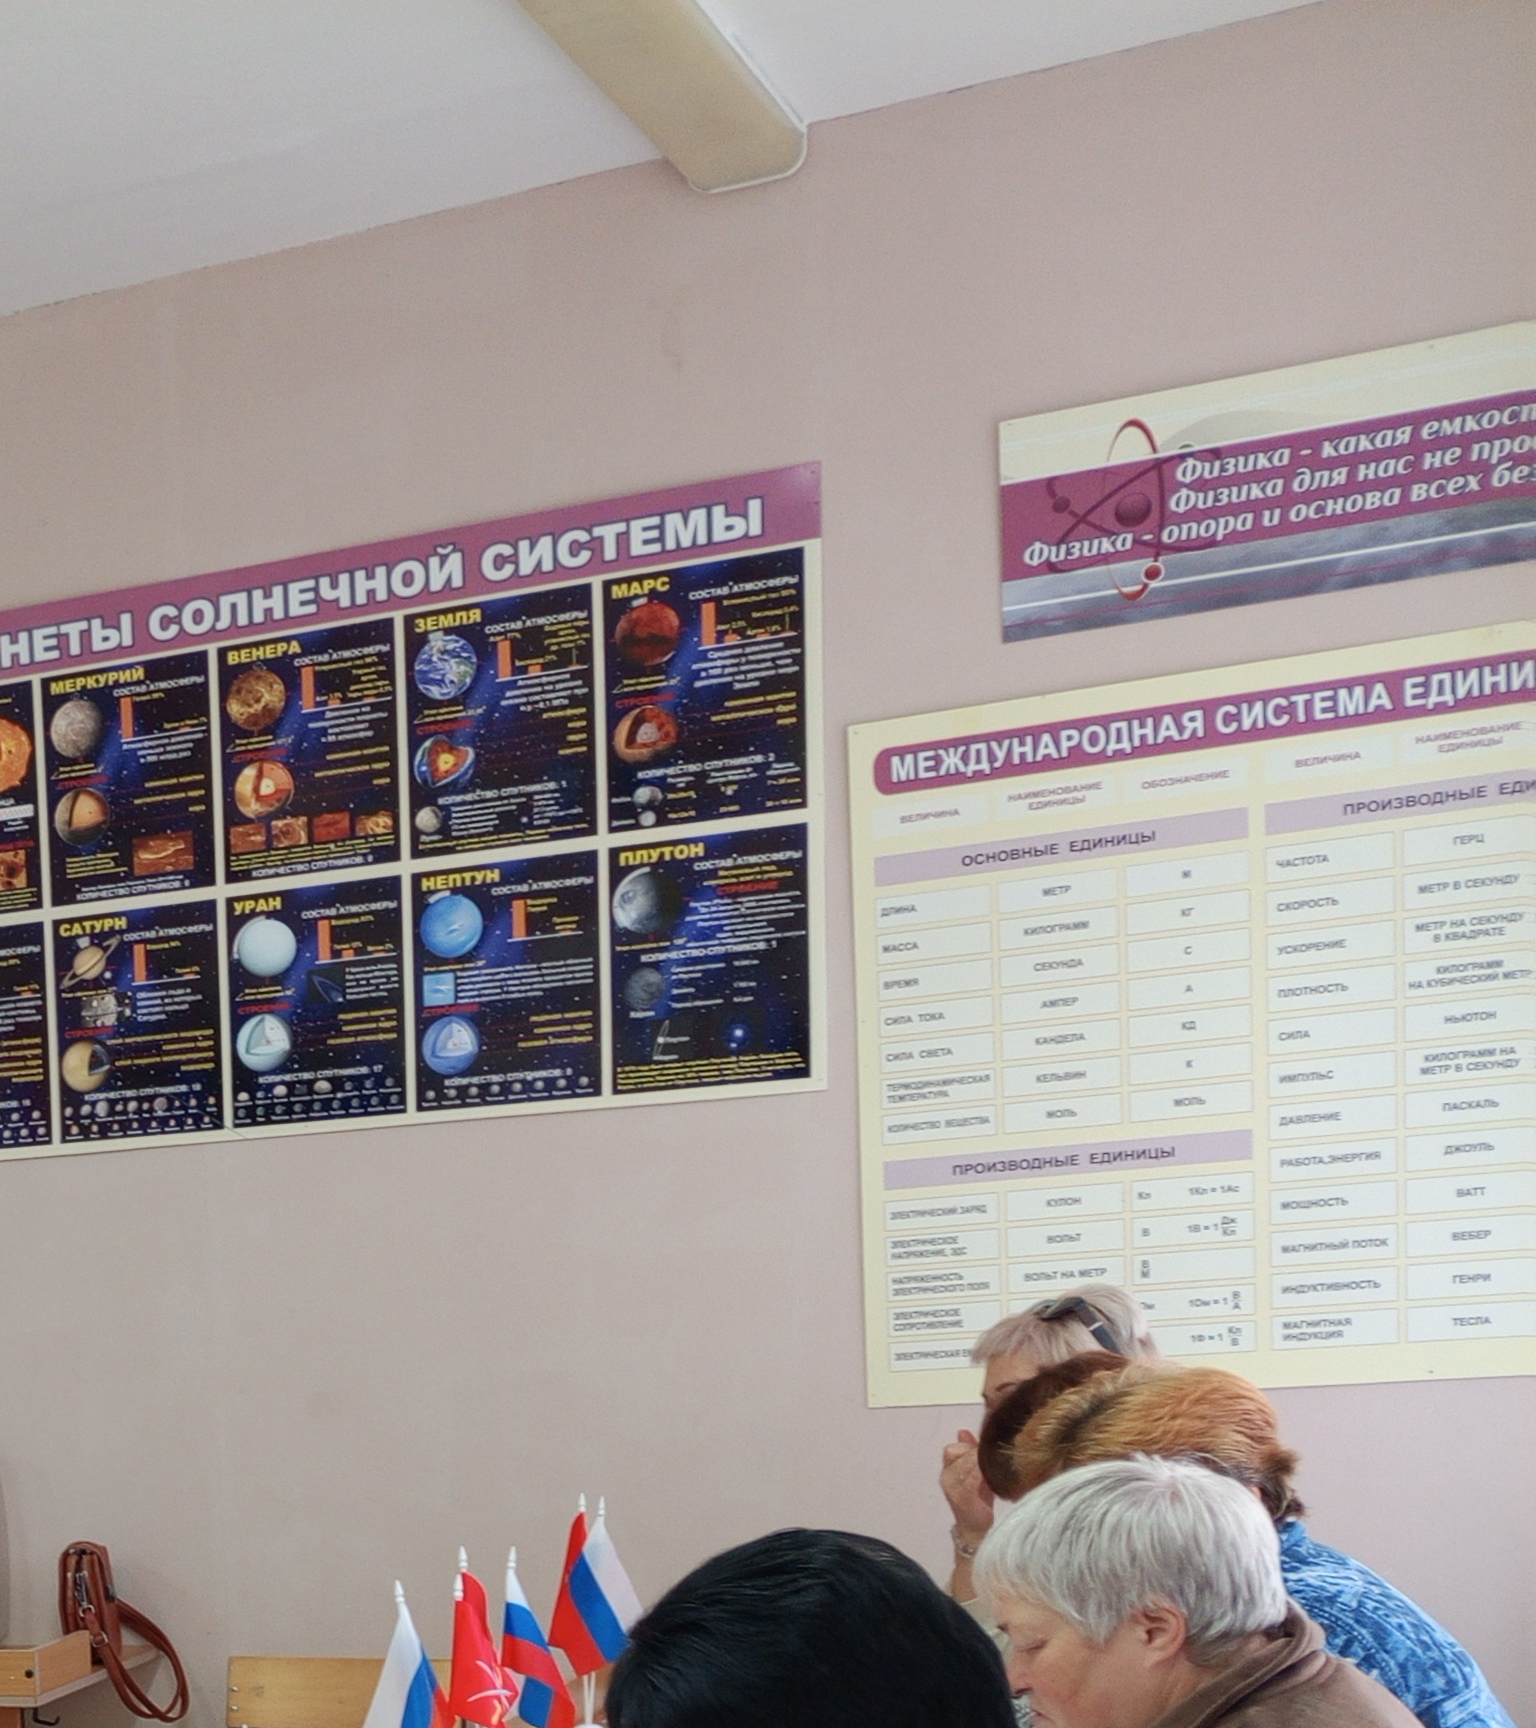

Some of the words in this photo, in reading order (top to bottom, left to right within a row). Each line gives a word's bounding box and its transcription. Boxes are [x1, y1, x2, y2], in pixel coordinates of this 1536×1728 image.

[1175, 447, 1290, 483] Физика
[1322, 425, 1410, 459] какая
[1170, 478, 1283, 513] Физика
[1293, 467, 1345, 492] для
[1357, 454, 1415, 480] нас
[1423, 447, 1462, 470] не
[1471, 434, 1536, 464] про
[1024, 533, 1133, 567] Физика
[1161, 512, 1253, 544] опора
[1261, 507, 1280, 526] и
[1288, 487, 1399, 523] основа
[1411, 474, 1483, 502] всех
[148, 547, 465, 643] СОЛНЕЧНОЙ
[480, 498, 765, 584] СИСТЕМЫ
[611, 576, 671, 599] МАРС
[414, 608, 482, 633] ЗЕМЛЯ
[227, 639, 302, 665] ВЕНЕРА
[51, 667, 145, 695] МЕРКУРИЙ
[890, 709, 1204, 783] МЕЖДУНАРОДНАЯ
[1215, 682, 1393, 735] СИСТЕМА
[1403, 660, 1536, 708] ЕДИНИ
[1415, 722, 1523, 745] НАИМЕНОВАНИЕ
[1438, 737, 1503, 754] ЕДИНИЦЫ
[1295, 751, 1361, 768] ВЕЛИЧИНА
[1141, 770, 1230, 791] ОБОЗНАЧЕНИЕ
[619, 842, 705, 866] ПЛУТОН
[961, 842, 1060, 867] ОСНОВНЫЕ
[1069, 830, 1156, 853] ЕДИНИЦЫ
[1276, 855, 1329, 869] ЧАСТОТА
[421, 869, 500, 892] НЕПТУН
[1041, 886, 1072, 898] МЕТР
[233, 897, 282, 915] УРАН
[1277, 897, 1339, 912] СКОРОСТЬ
[59, 917, 127, 937] САТУРН
[882, 941, 919, 953] МАССА
[1277, 939, 1347, 956] УСКОРЕНИЕ
[1034, 958, 1084, 972] СЕКУНДА
[883, 978, 919, 990] ВРЕМЯ
[1278, 983, 1349, 999] ПЛОТНОСТЬ
[918, 1011, 945, 1022] ТОКА
[1444, 1011, 1497, 1025] НЬЮТОН
[1035, 1032, 1086, 1046] КАНДЕЛА
[1036, 1069, 1086, 1084] КЕЛЬВИН
[1279, 1070, 1334, 1084] ИМПУЛЬС
[1442, 1099, 1500, 1112] ПАСКАЛЬ
[1279, 1112, 1342, 1127] ДАВЛЕНИЕ
[952, 1154, 1080, 1177] ПРОИЗВОДНЫЕ
[1089, 1146, 1177, 1166] ЕДИНИЦЫ
[1456, 1187, 1486, 1198] ВАТТ
[1281, 1197, 1349, 1211] МОЩНОСТЬ
[1047, 1233, 1082, 1244] ВОЛЬТ
[1452, 1230, 1492, 1241] ВЕБЕР
[1452, 1273, 1491, 1284] ГЕНРИ
[1281, 1279, 1381, 1295] ИНДУКТИВНОСТЬ
